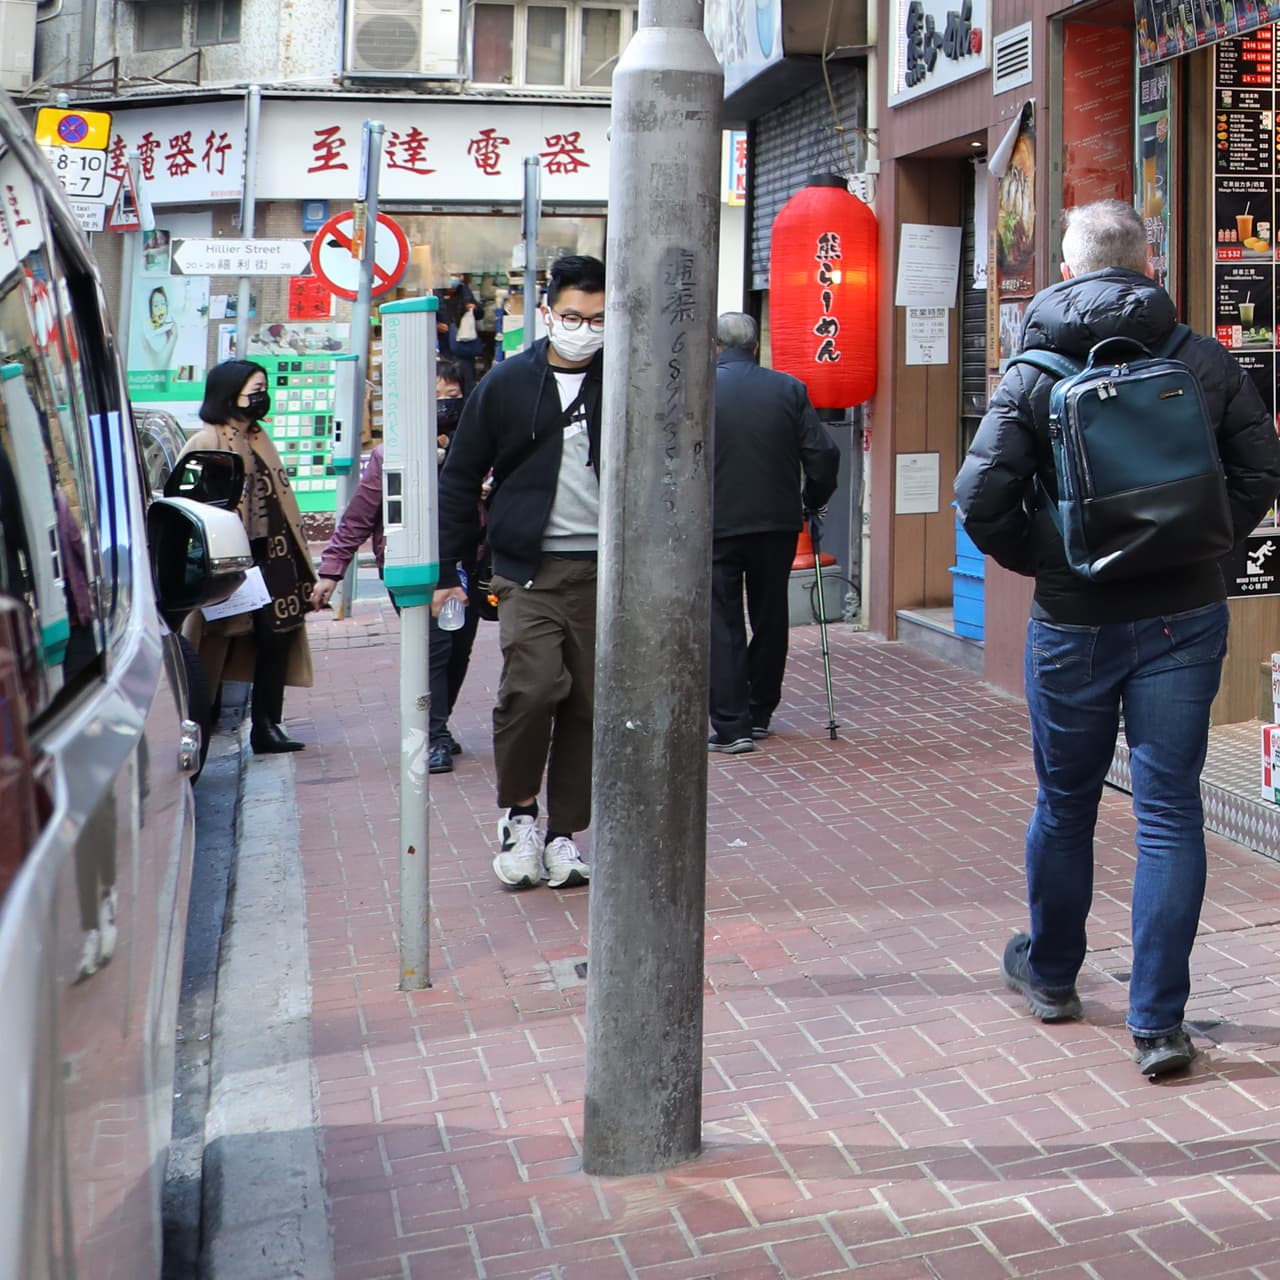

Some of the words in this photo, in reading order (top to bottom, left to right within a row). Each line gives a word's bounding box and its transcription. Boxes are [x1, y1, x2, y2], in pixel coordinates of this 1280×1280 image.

[307, 125, 591, 177] 至達電器
[206, 244, 240, 254] Hillier
[245, 244, 281, 254] Street
